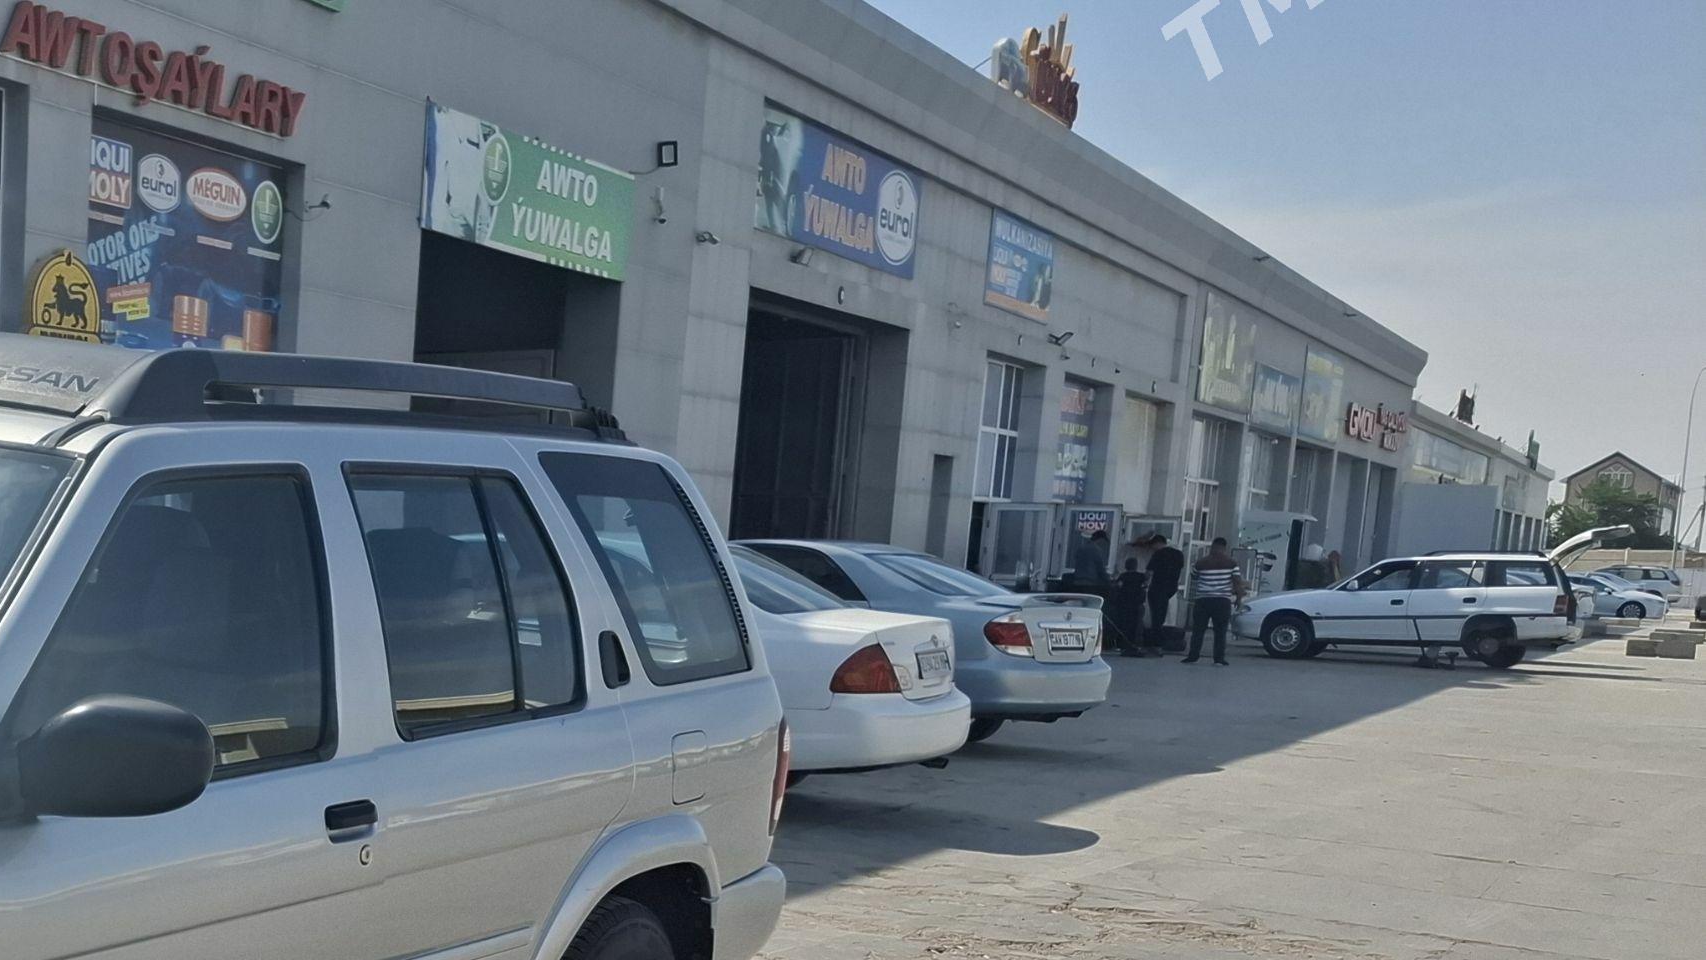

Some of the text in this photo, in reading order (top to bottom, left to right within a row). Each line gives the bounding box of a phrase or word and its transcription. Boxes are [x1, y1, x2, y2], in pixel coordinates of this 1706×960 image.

[90, 140, 130, 173] IQUI
[821, 143, 867, 195] AWTO
[141, 175, 177, 198] eurol
[537, 159, 598, 208] AWTO
[511, 196, 613, 263] ÝUWALGA
[803, 183, 875, 254] ÝUWALGA
[879, 206, 914, 238] eurol
[87, 230, 126, 266] OTOR
[1077, 521, 1107, 531] MOLY
